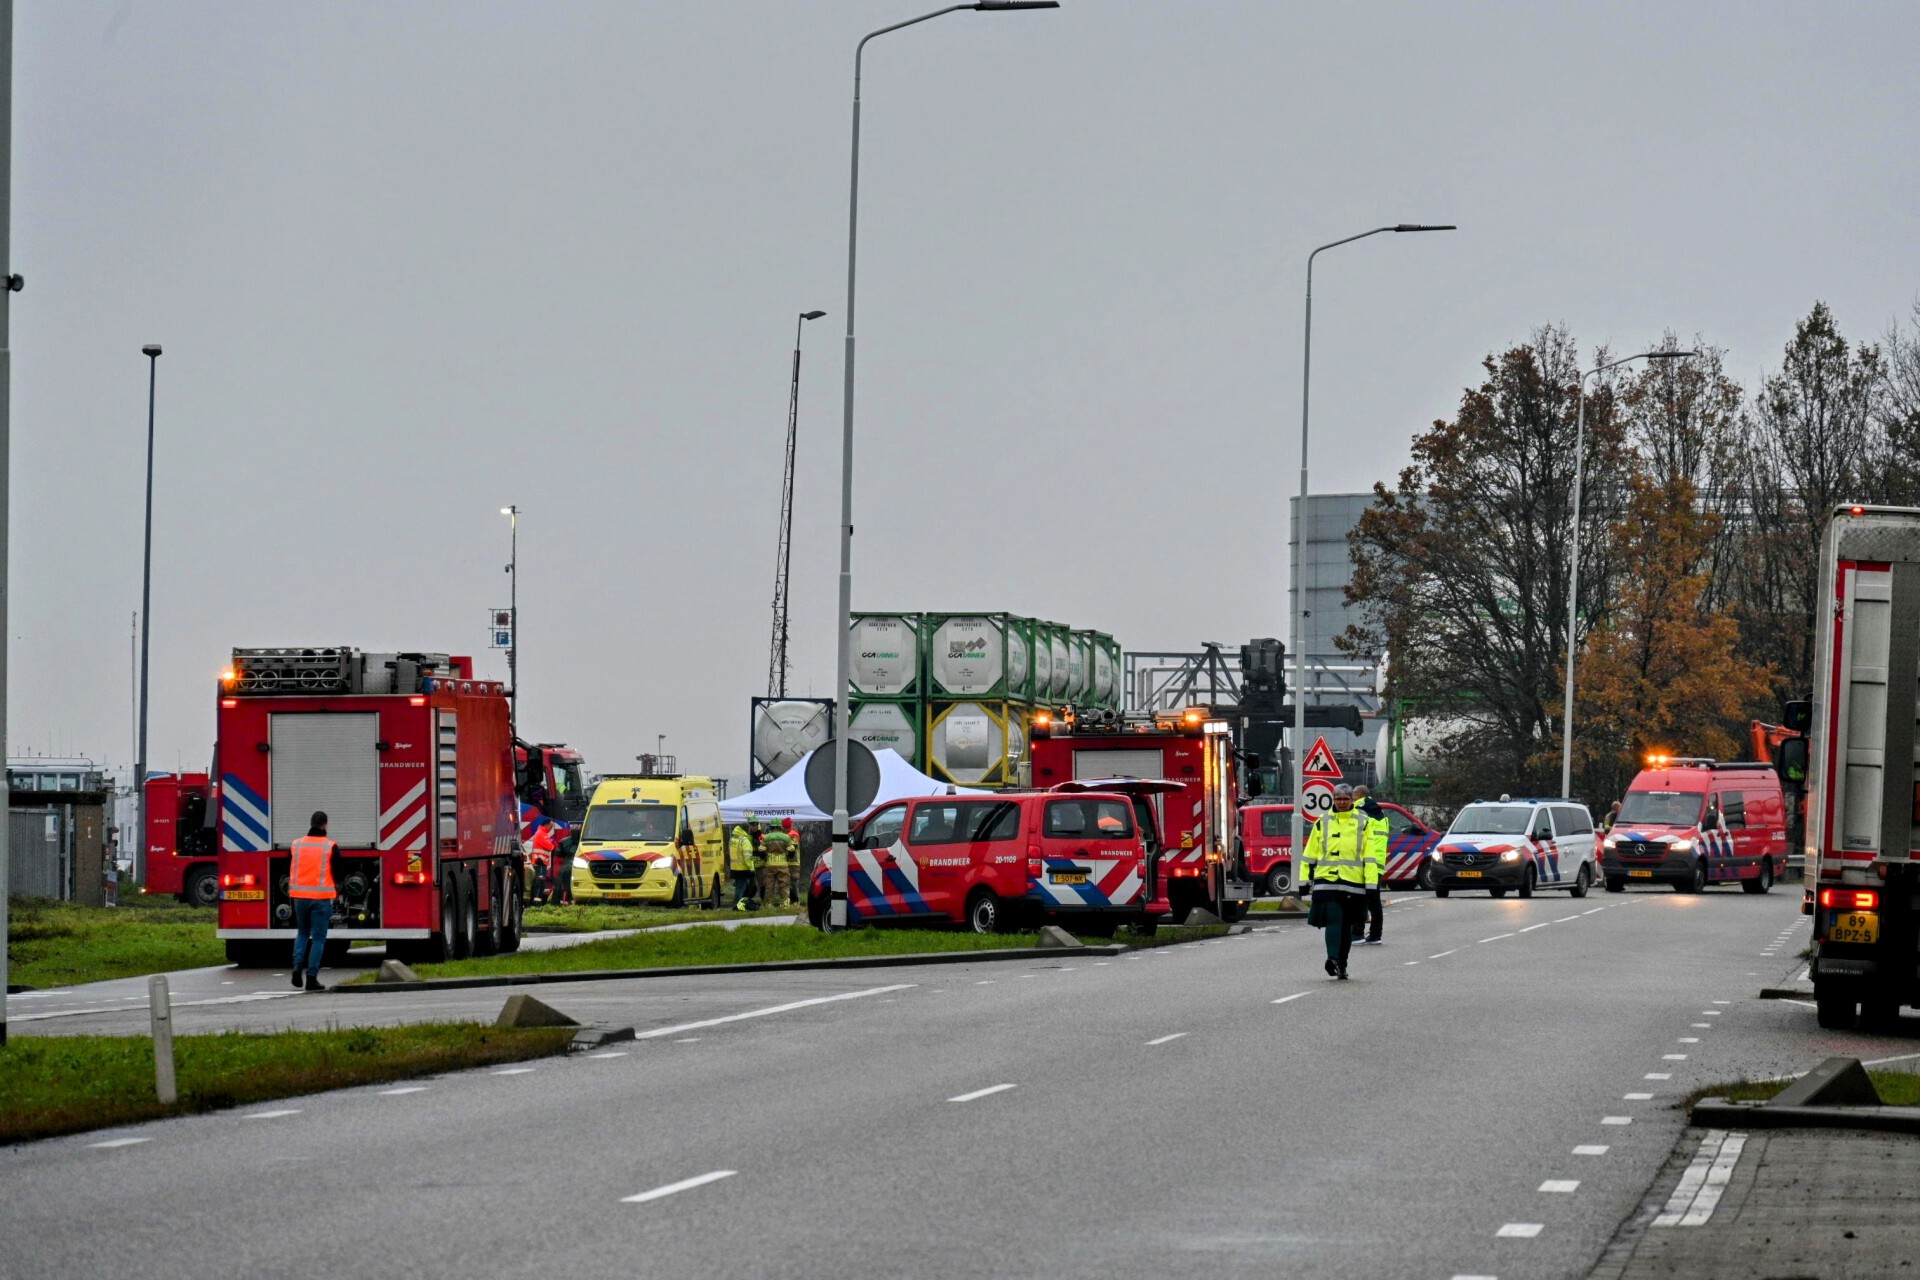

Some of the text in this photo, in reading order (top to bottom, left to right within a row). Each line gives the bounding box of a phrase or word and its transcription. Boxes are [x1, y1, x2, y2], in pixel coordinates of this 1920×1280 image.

[499, 634, 506, 643] F
[1304, 792, 1333, 811] 30
[929, 856, 1016, 867] BRANDWEER 20-1109
[1849, 916, 1866, 927] 89
[1835, 929, 1871, 941] BPZ-5
